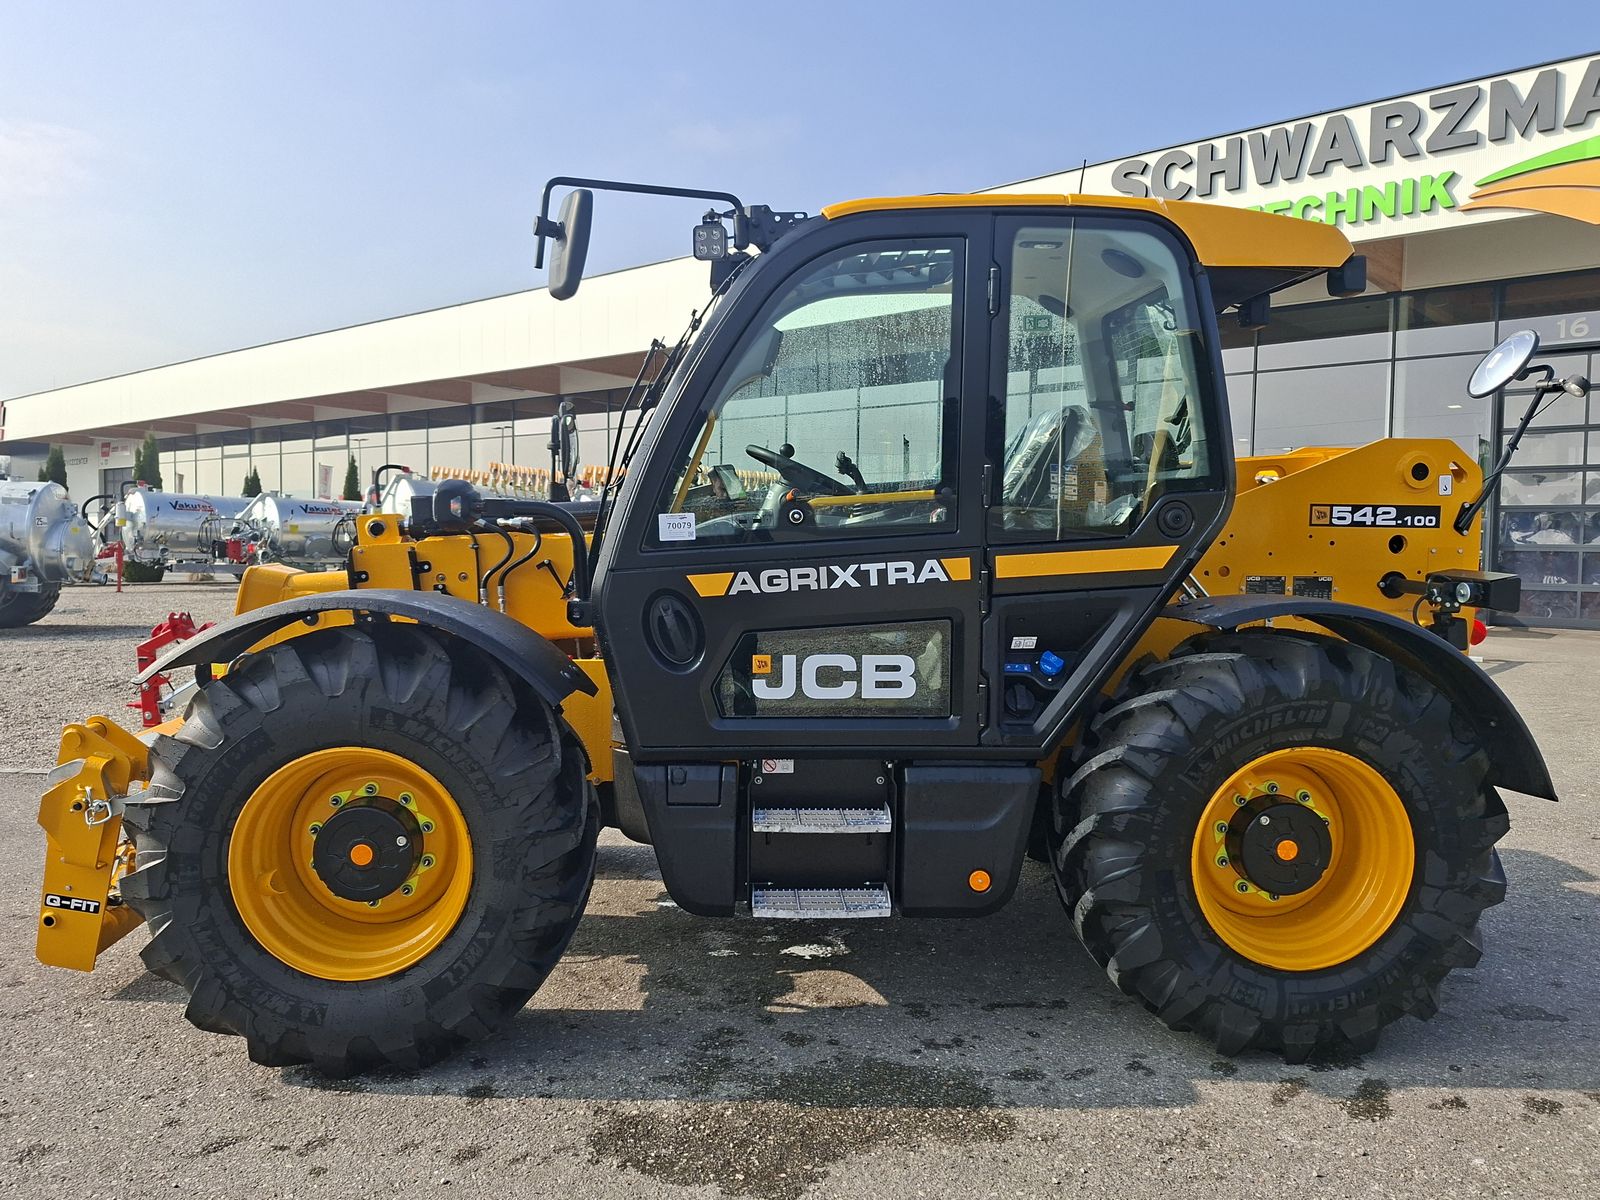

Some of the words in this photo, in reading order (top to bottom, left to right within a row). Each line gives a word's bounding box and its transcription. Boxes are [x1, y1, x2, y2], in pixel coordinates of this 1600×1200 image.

[1246, 171, 1456, 226] CHNIK
[1556, 317, 1590, 338] 16
[667, 521, 692, 530] 70079
[1331, 506, 1437, 526] 542-100
[728, 560, 949, 596] AGRIXTRA
[752, 655, 917, 700] JCB
[1213, 707, 1328, 761] MICHELIN
[46, 895, 99, 912] Q-FIT
